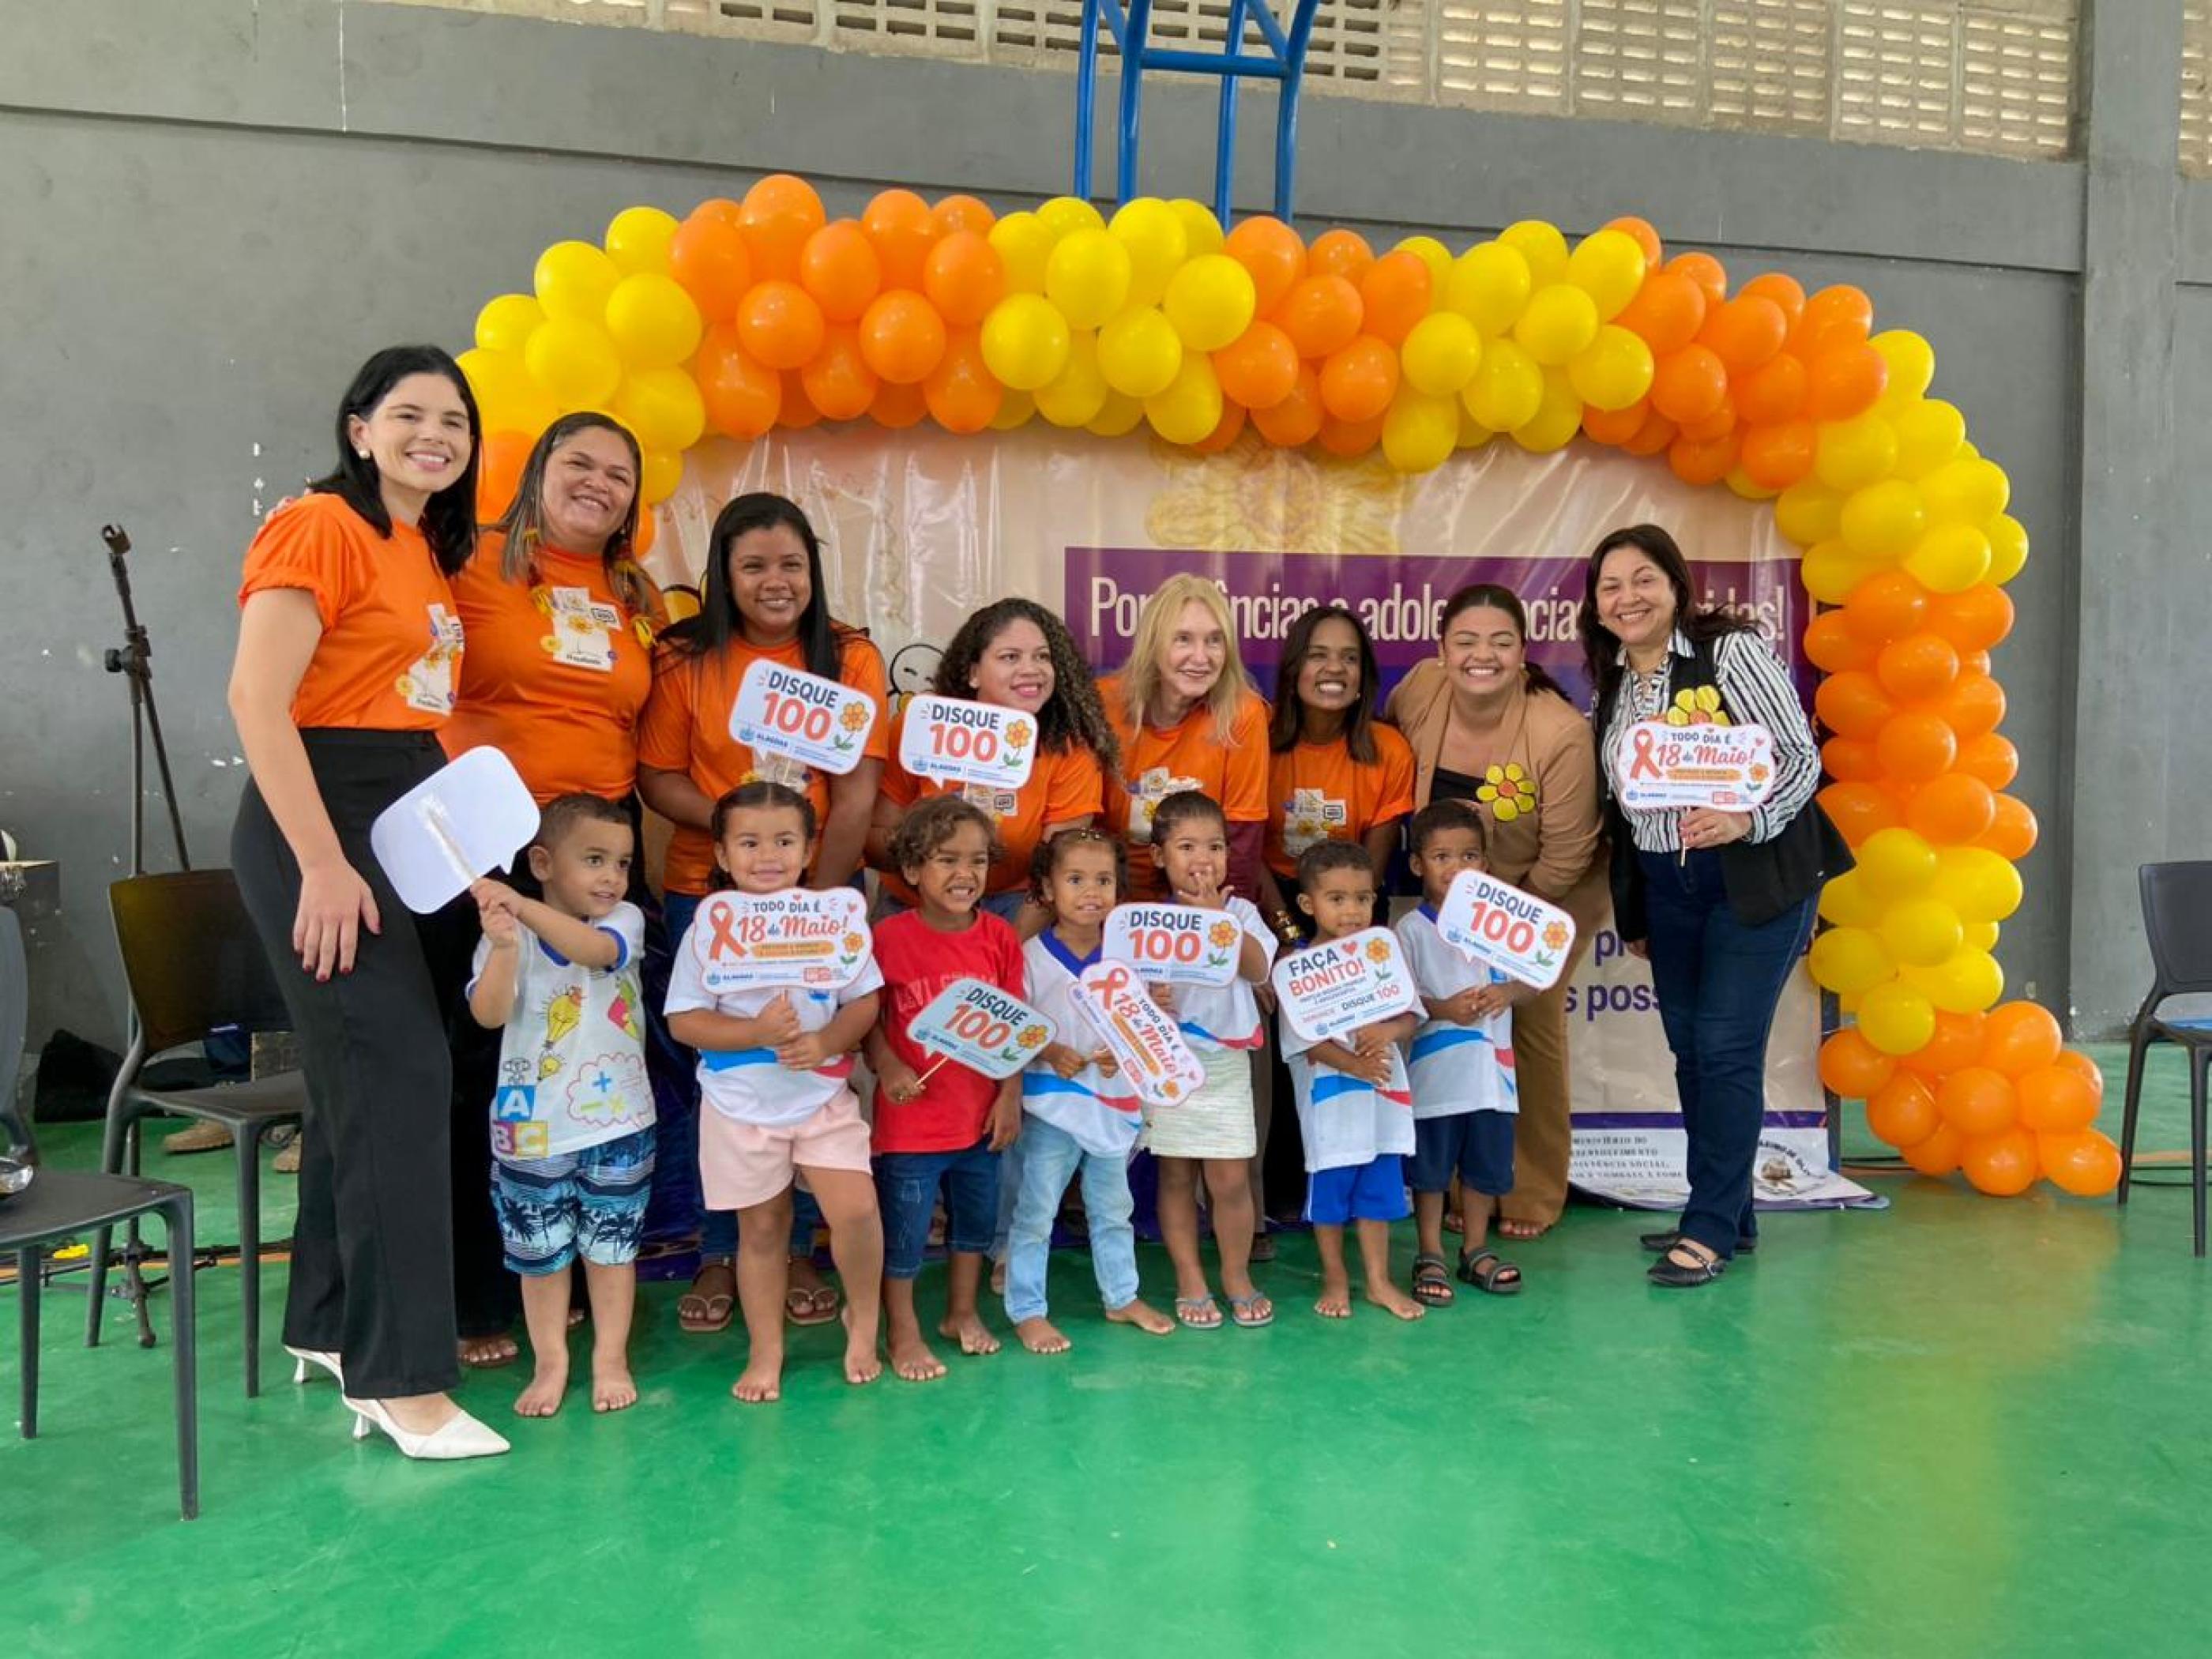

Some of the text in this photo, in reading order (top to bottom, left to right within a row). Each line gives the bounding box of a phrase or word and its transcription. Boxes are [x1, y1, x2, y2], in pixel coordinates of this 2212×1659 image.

[768, 670, 839, 709] DISQUE
[762, 691, 832, 741] 100
[931, 703, 1001, 730] DISQUE
[929, 723, 998, 762] 100
[1670, 732, 1698, 743] TODO
[1702, 734, 1722, 744] DIA
[1657, 743, 1682, 766] 18
[1694, 745, 1755, 765] Maio!
[752, 901, 785, 912] TODO
[789, 901, 811, 913] DIA
[1477, 882, 1544, 924] DISQUE
[737, 915, 766, 942] 18
[780, 915, 849, 937] Maio!
[1130, 910, 1203, 931] DISQUE
[1470, 901, 1535, 953] 100
[1128, 929, 1202, 962] 100
[1288, 948, 1340, 977] FAÇA
[1288, 957, 1367, 996] BONITO!
[965, 987, 1029, 1025] DISQUE
[1139, 999, 1161, 1024] TODO
[1341, 993, 1375, 1010] DISQUE
[1376, 984, 1400, 999] 100
[943, 1003, 1012, 1050] 100
[1114, 993, 1140, 1018] 18
[1139, 1024, 1185, 1077] Maio!
[498, 1089, 530, 1117] A
[495, 1124, 544, 1151] B C
